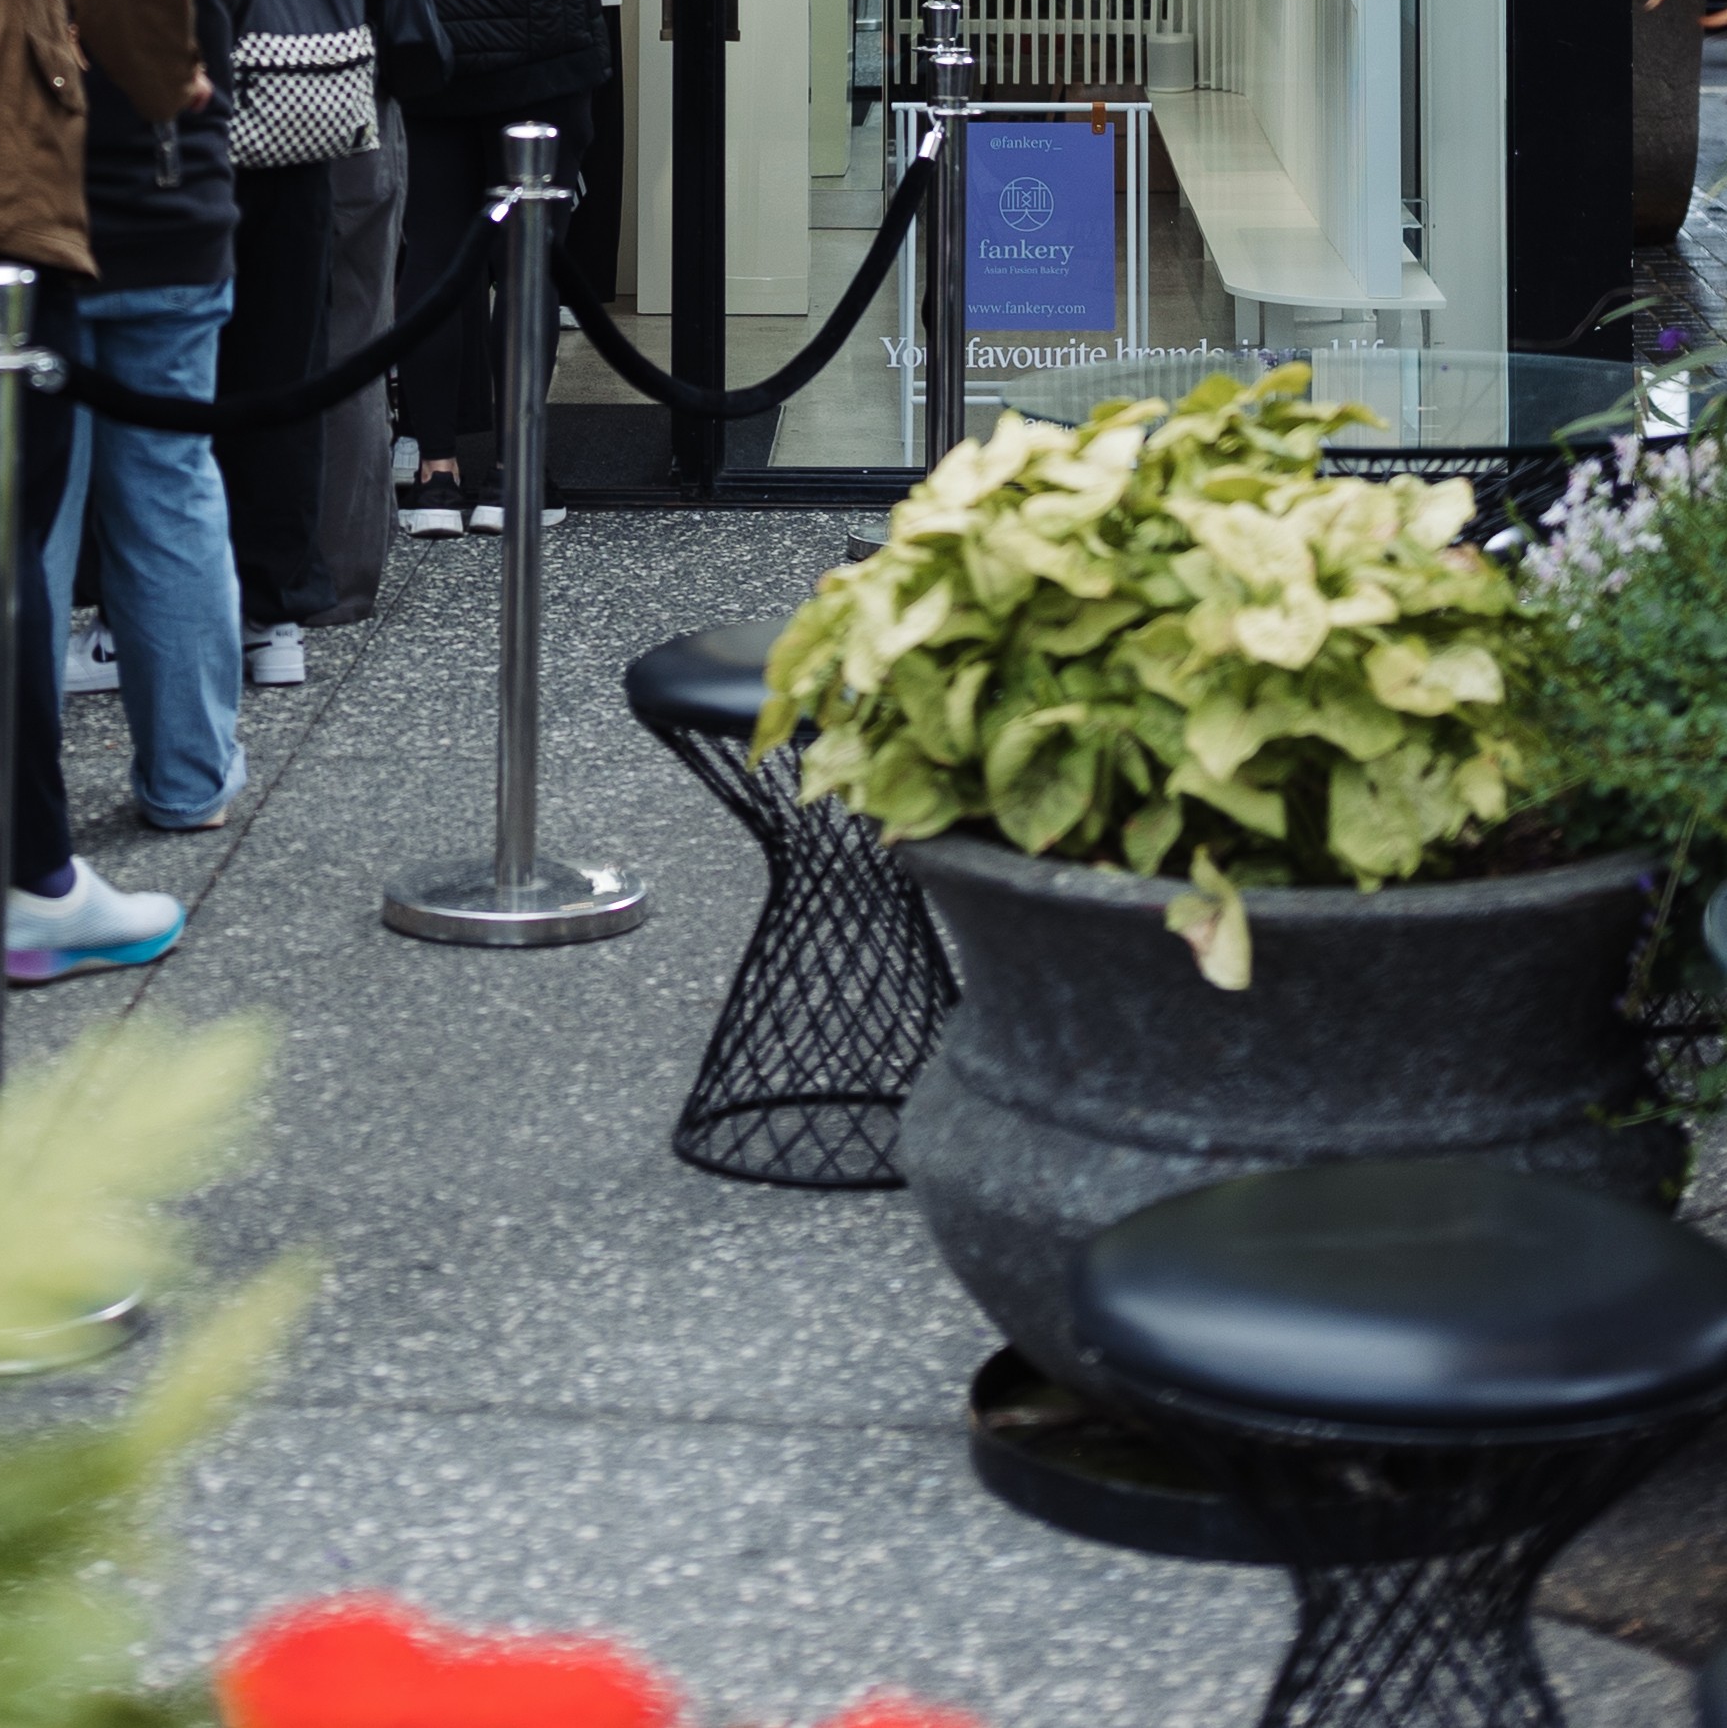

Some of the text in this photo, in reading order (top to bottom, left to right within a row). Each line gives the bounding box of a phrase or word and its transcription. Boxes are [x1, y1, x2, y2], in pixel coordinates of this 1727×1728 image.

[990, 136, 1062, 152] @fankery_
[978, 239, 1074, 265] fankery
[984, 265, 1069, 276] Asian Fusion Bakery
[968, 301, 1086, 317] www.fankery.com
[879, 336, 926, 368] Yo
[966, 337, 1107, 368] favourite
